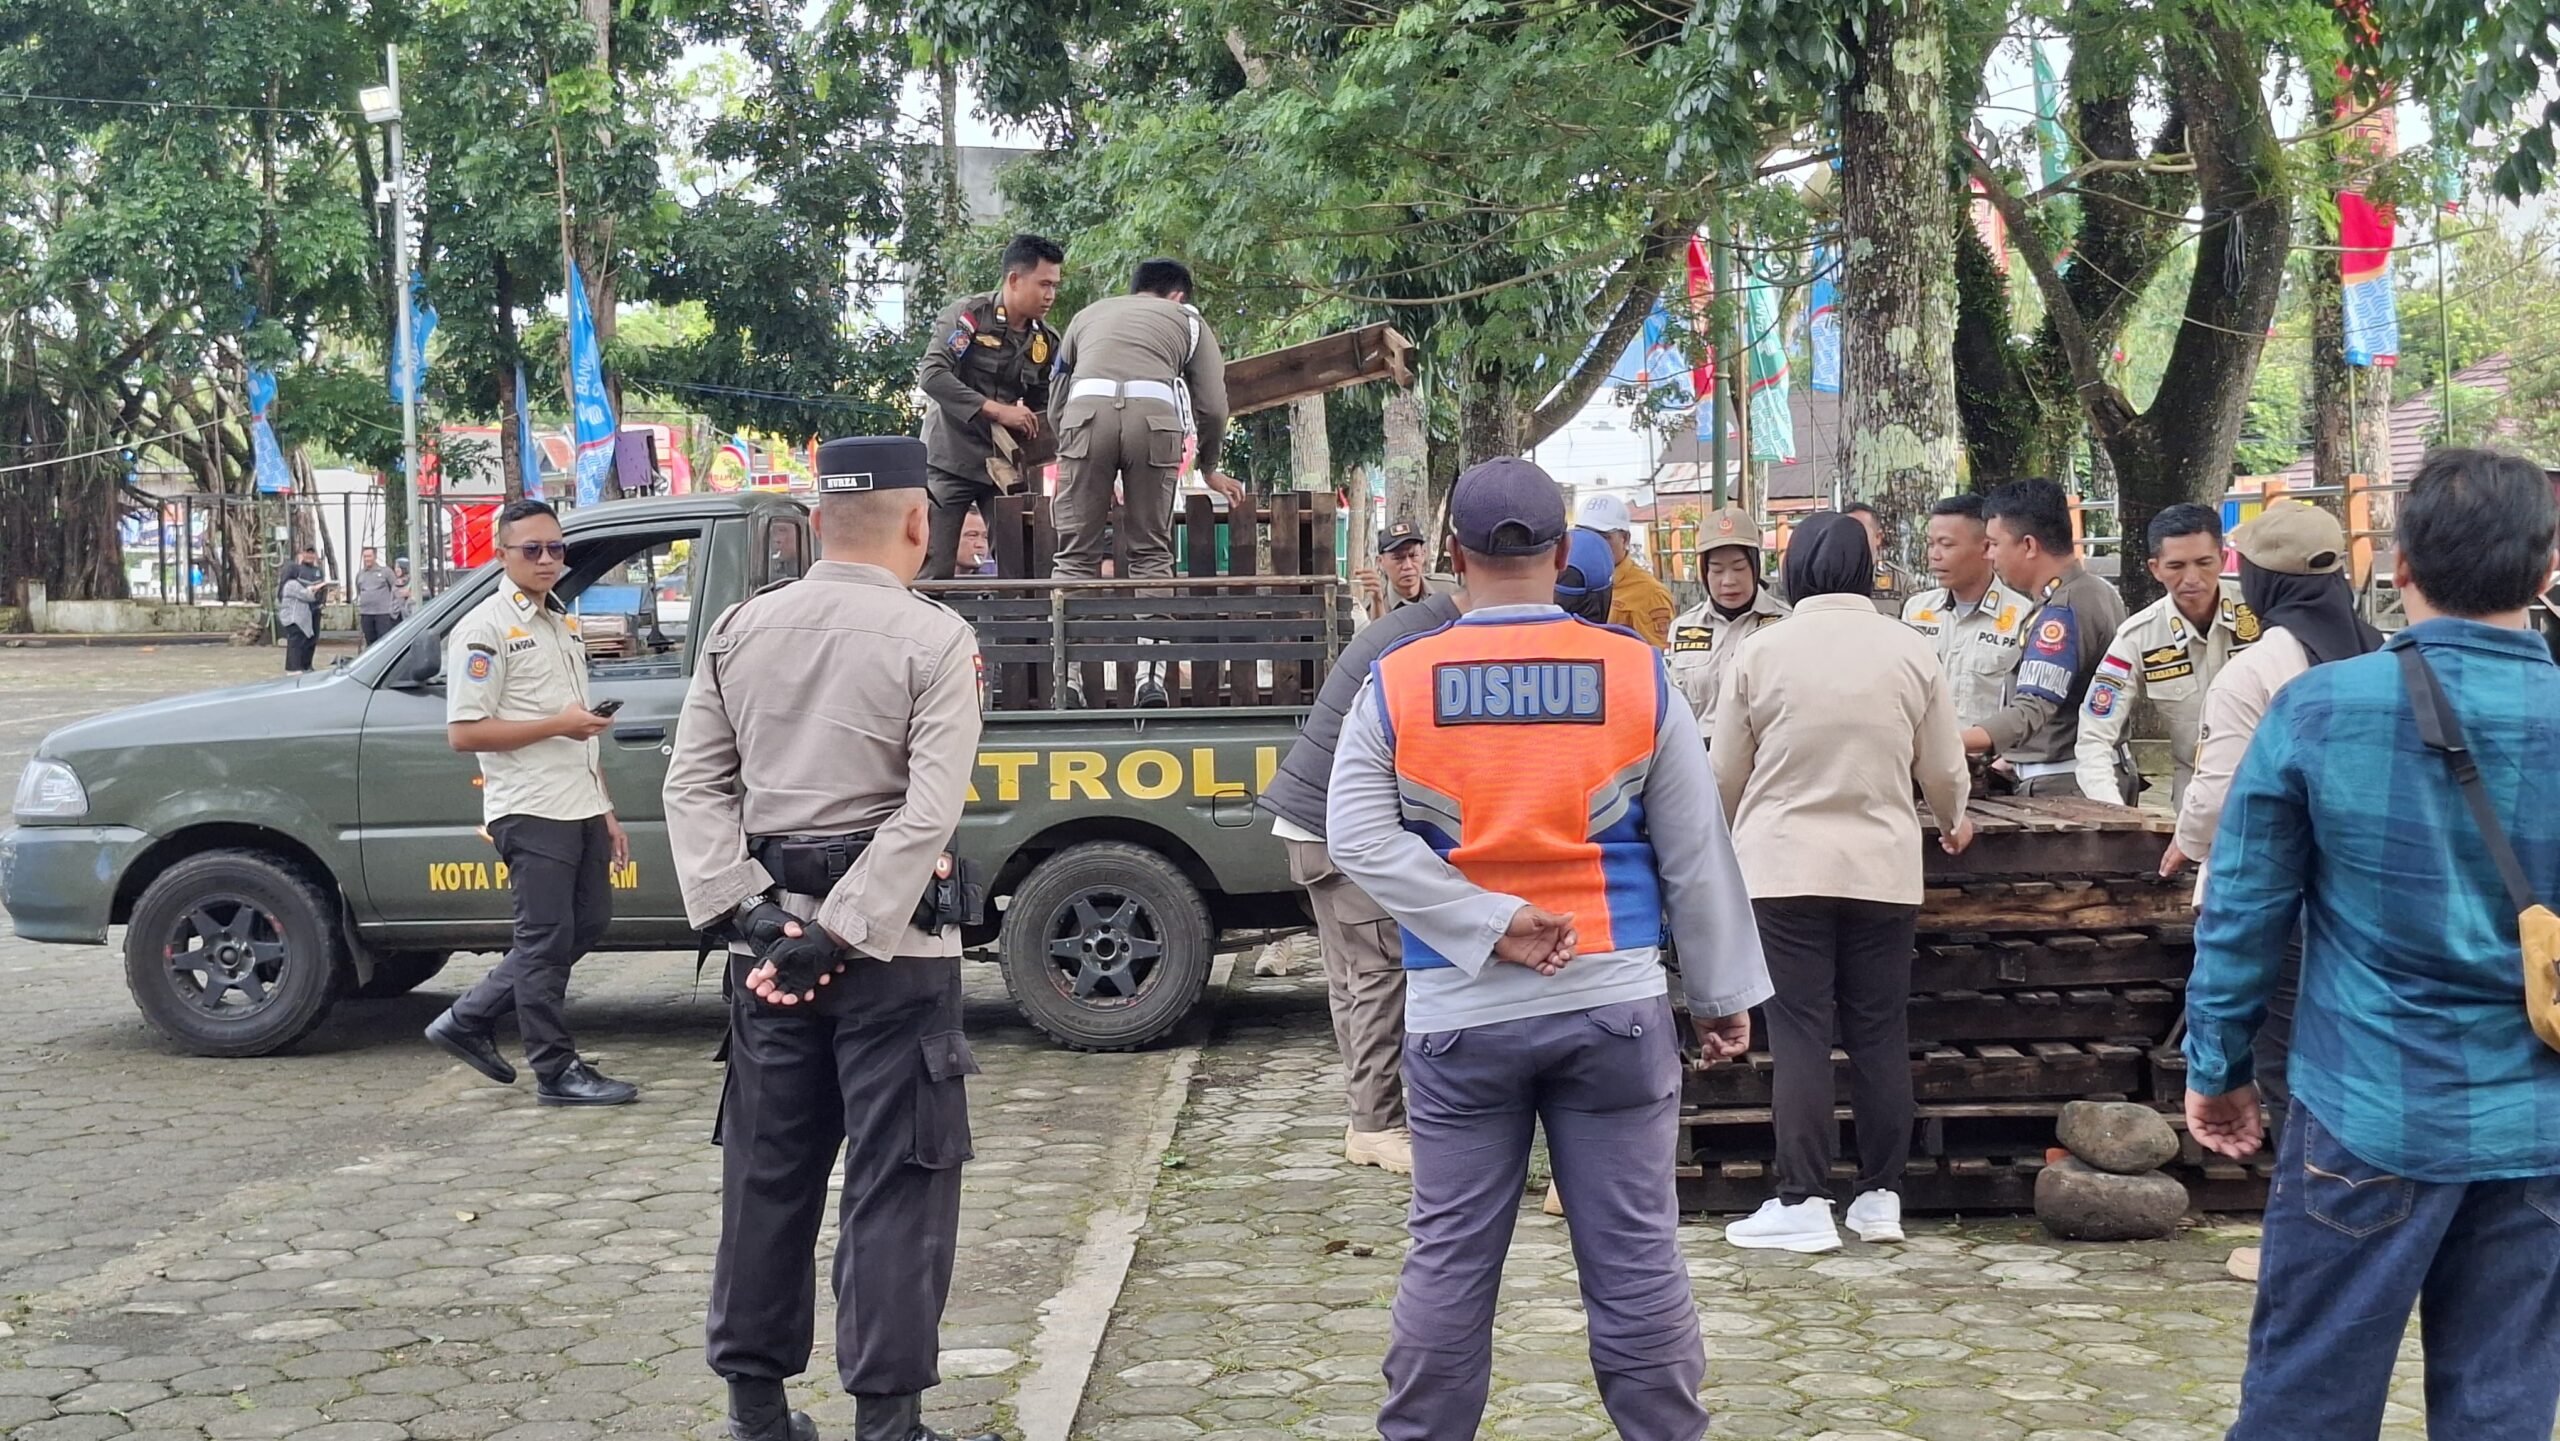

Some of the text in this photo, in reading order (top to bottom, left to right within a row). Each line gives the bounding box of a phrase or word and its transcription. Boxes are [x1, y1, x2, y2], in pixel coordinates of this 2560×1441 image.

[1978, 631, 2016, 648] POL PP
[1440, 665, 1599, 717] DISHUB
[2016, 660, 2071, 699] AMWAL
[965, 746, 1277, 801] TROLI
[429, 862, 490, 891] KOTA
